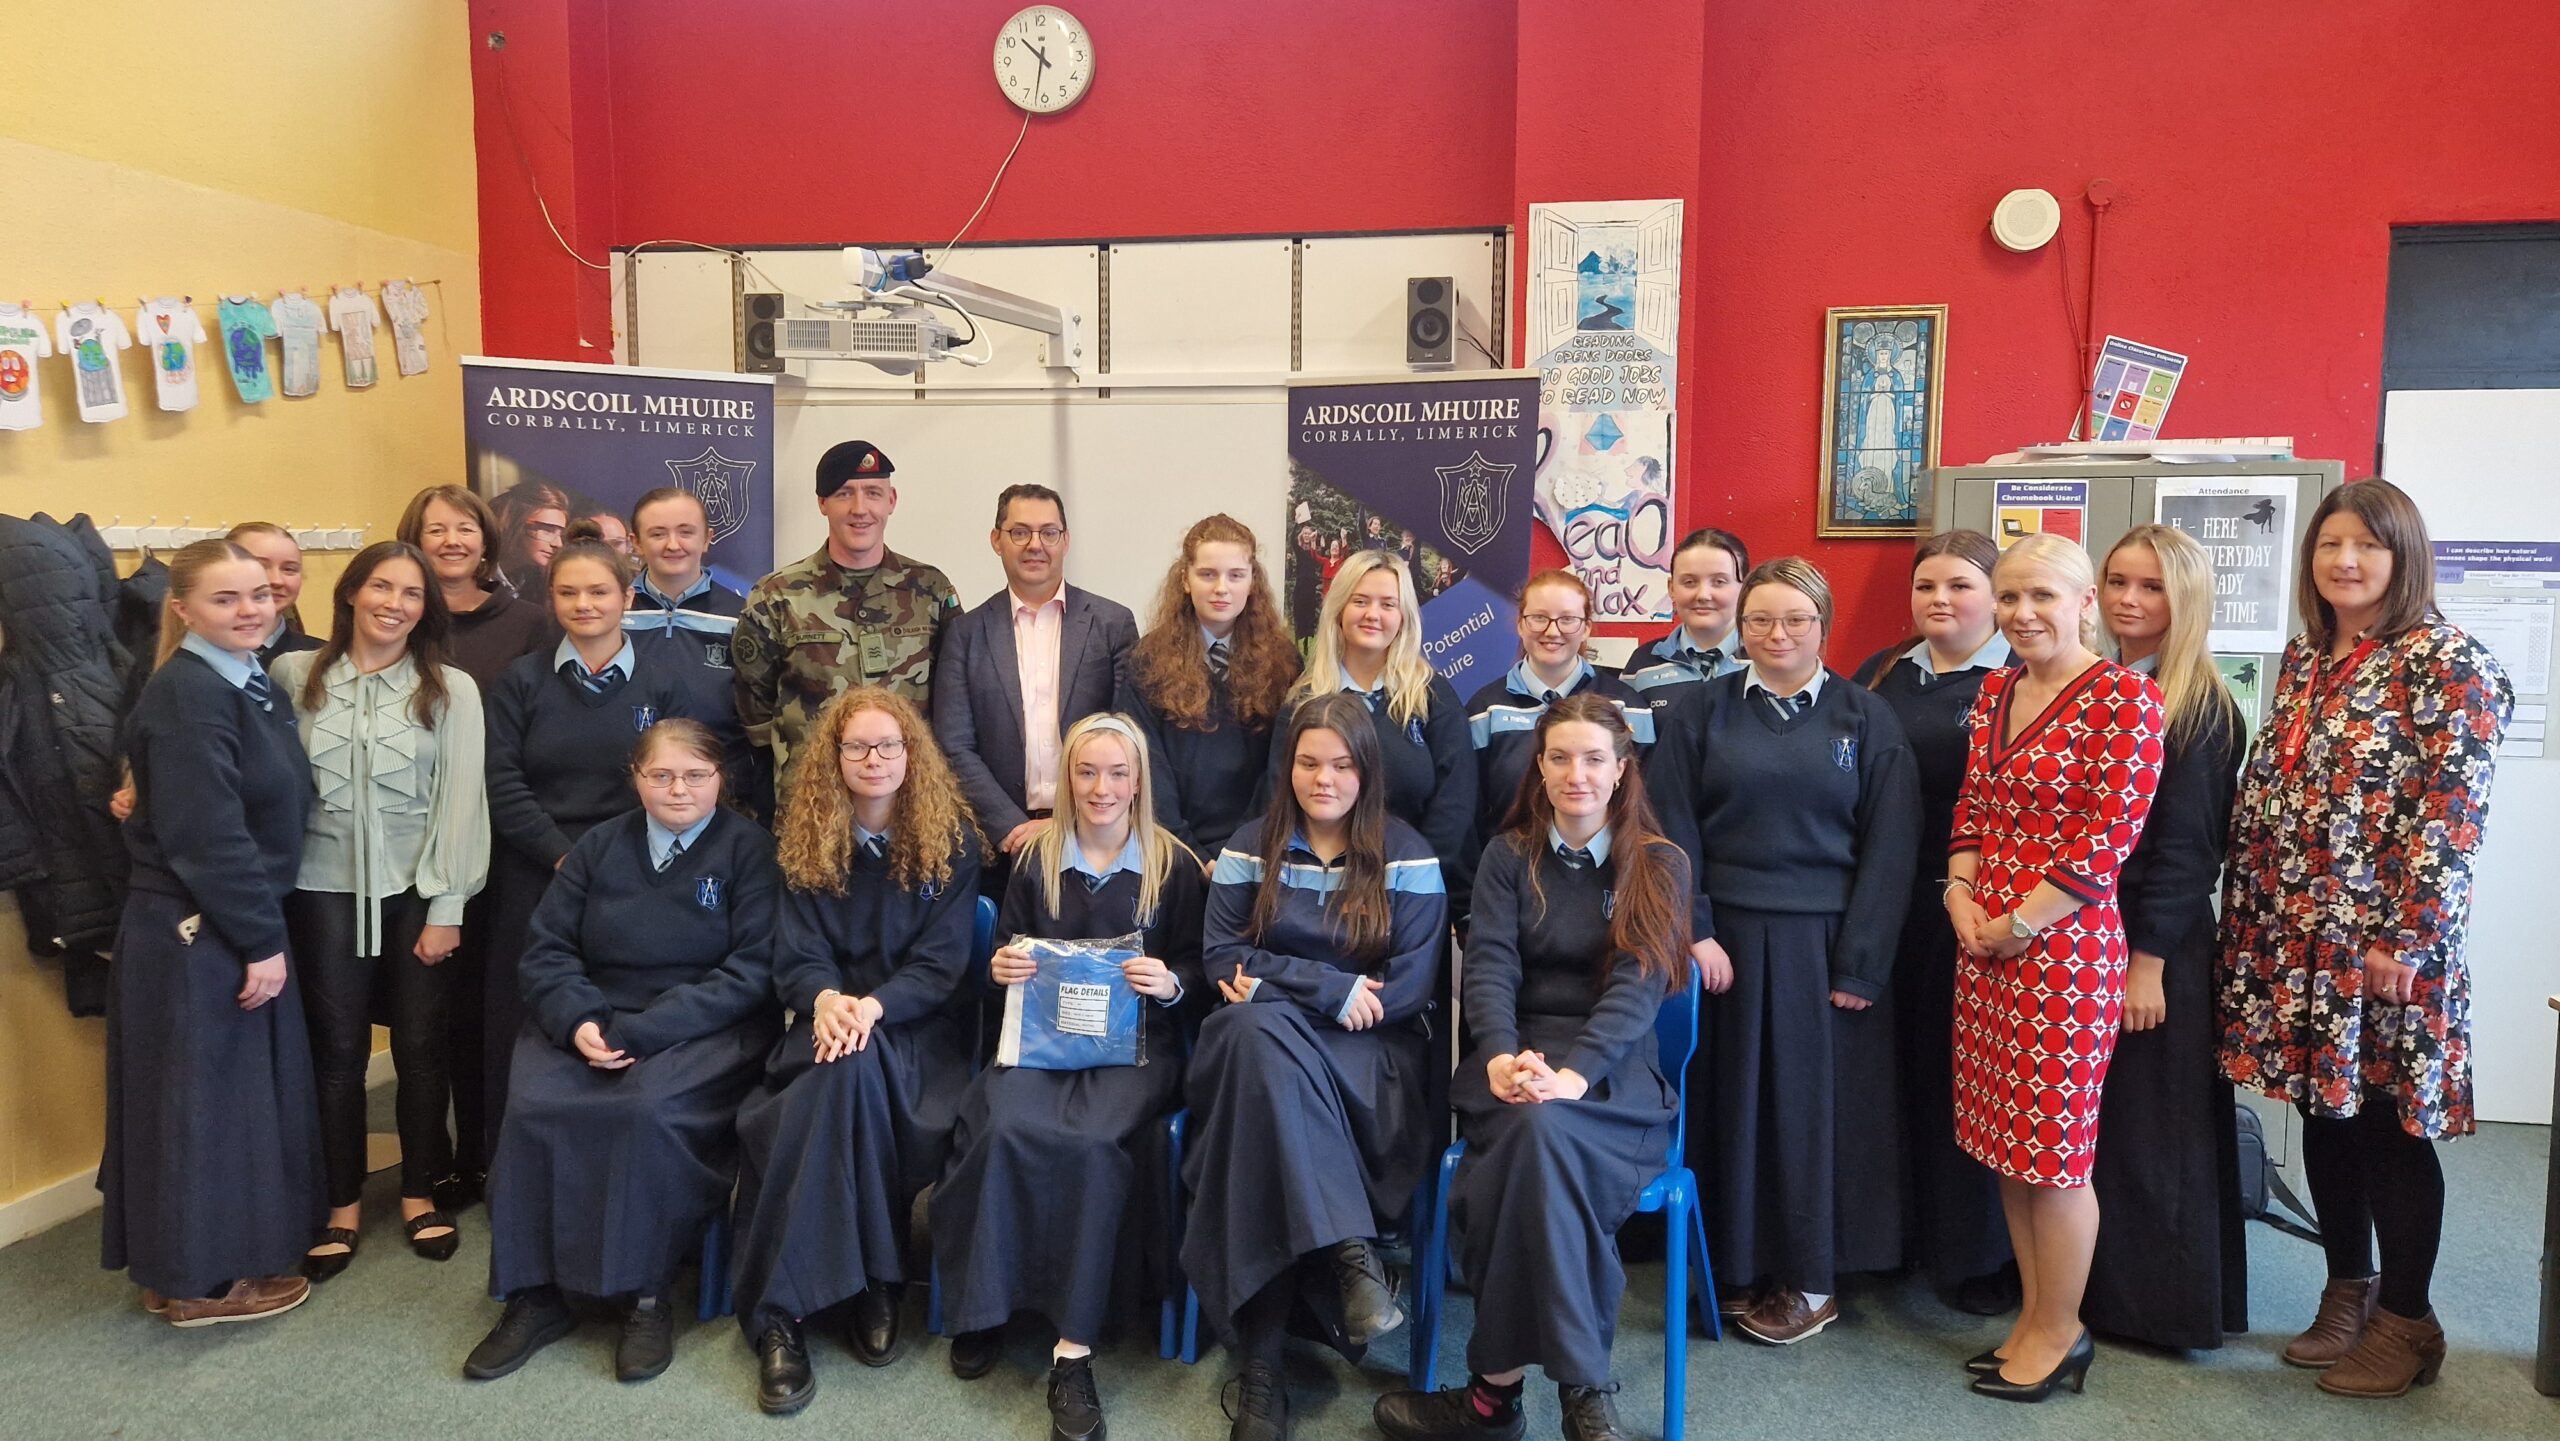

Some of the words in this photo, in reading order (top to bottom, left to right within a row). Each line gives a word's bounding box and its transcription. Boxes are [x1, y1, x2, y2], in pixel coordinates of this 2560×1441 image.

[1035, 14, 1046, 26] 12
[1019, 21, 1028, 33] 11
[1006, 36, 1016, 48] 10
[1069, 31, 1077, 43] 2
[1003, 56, 1012, 68] 9
[1075, 50, 1084, 62] 3
[1009, 75, 1017, 87] 8
[1070, 70, 1078, 81] 4
[1023, 88, 1031, 99] 7
[1059, 85, 1067, 97] 5
[1040, 92, 1050, 103] 6
[1572, 335, 1634, 348] READING
[1555, 350, 1600, 363] OPENS
[1605, 349, 1652, 362] DOORS
[1542, 367, 1561, 386] TO
[1567, 365, 1614, 386] GOOD
[1620, 365, 1661, 384] JOBS
[1540, 389, 1555, 405] O
[1561, 387, 1615, 405] READ
[1621, 388, 1666, 406] NOW
[486, 387, 637, 414] ARDSCOIL
[643, 395, 755, 420] MHUIRE
[1302, 403, 1415, 426] ARDSCOIL
[1420, 399, 1520, 422] MHUIRE
[487, 412, 626, 433] CORBALLY,
[640, 421, 755, 437] LIMERICK
[1302, 428, 1405, 443] CORBALLY,
[1416, 425, 1518, 440] LIMERICK
[2198, 487, 2250, 495] Attendance
[2202, 517, 2240, 539] HERE
[2213, 573, 2246, 595] ADY
[1423, 603, 1494, 660] Potential
[1060, 985, 1079, 995] FLAG
[1080, 987, 1108, 997] DETAILS
